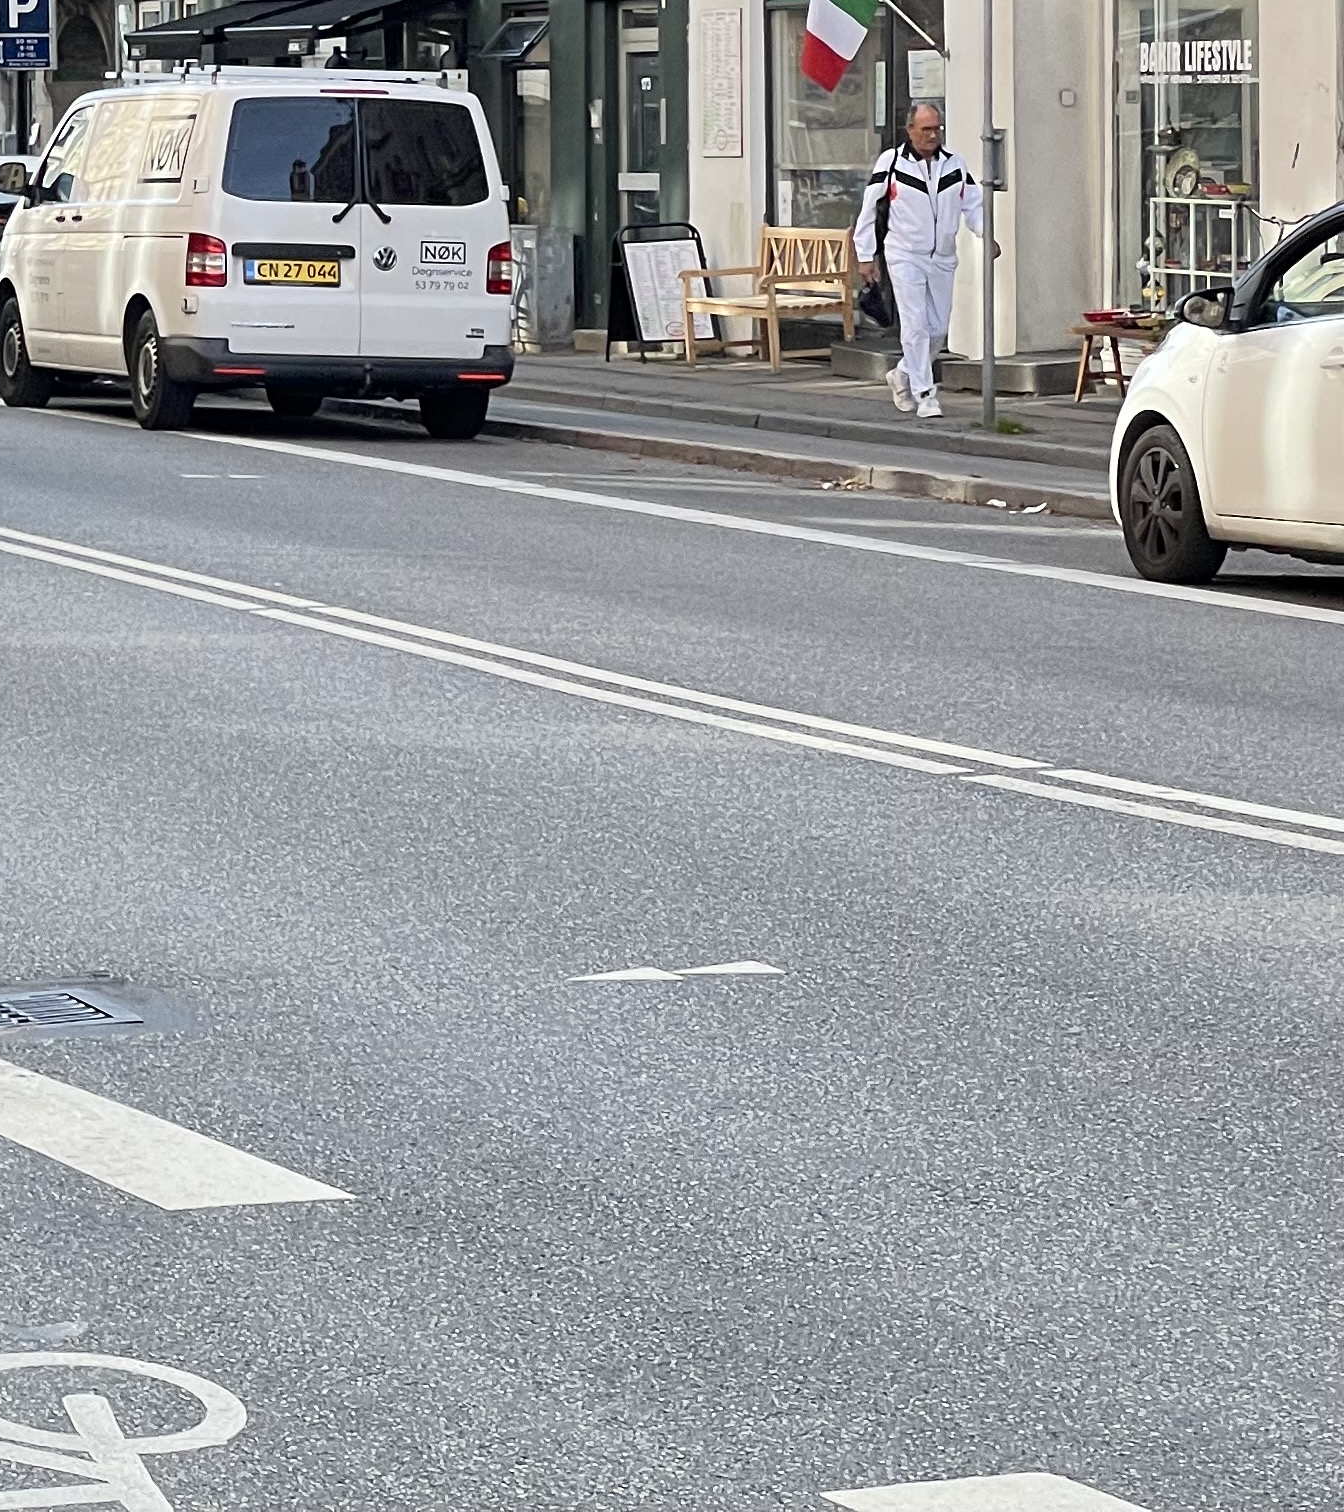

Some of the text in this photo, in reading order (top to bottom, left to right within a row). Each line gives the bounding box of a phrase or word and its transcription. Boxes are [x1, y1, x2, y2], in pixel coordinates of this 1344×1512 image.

[1184, 39, 1252, 72] LIFESTYLE
[424, 245, 462, 261] NØK
[257, 262, 337, 280] CN 27 044
